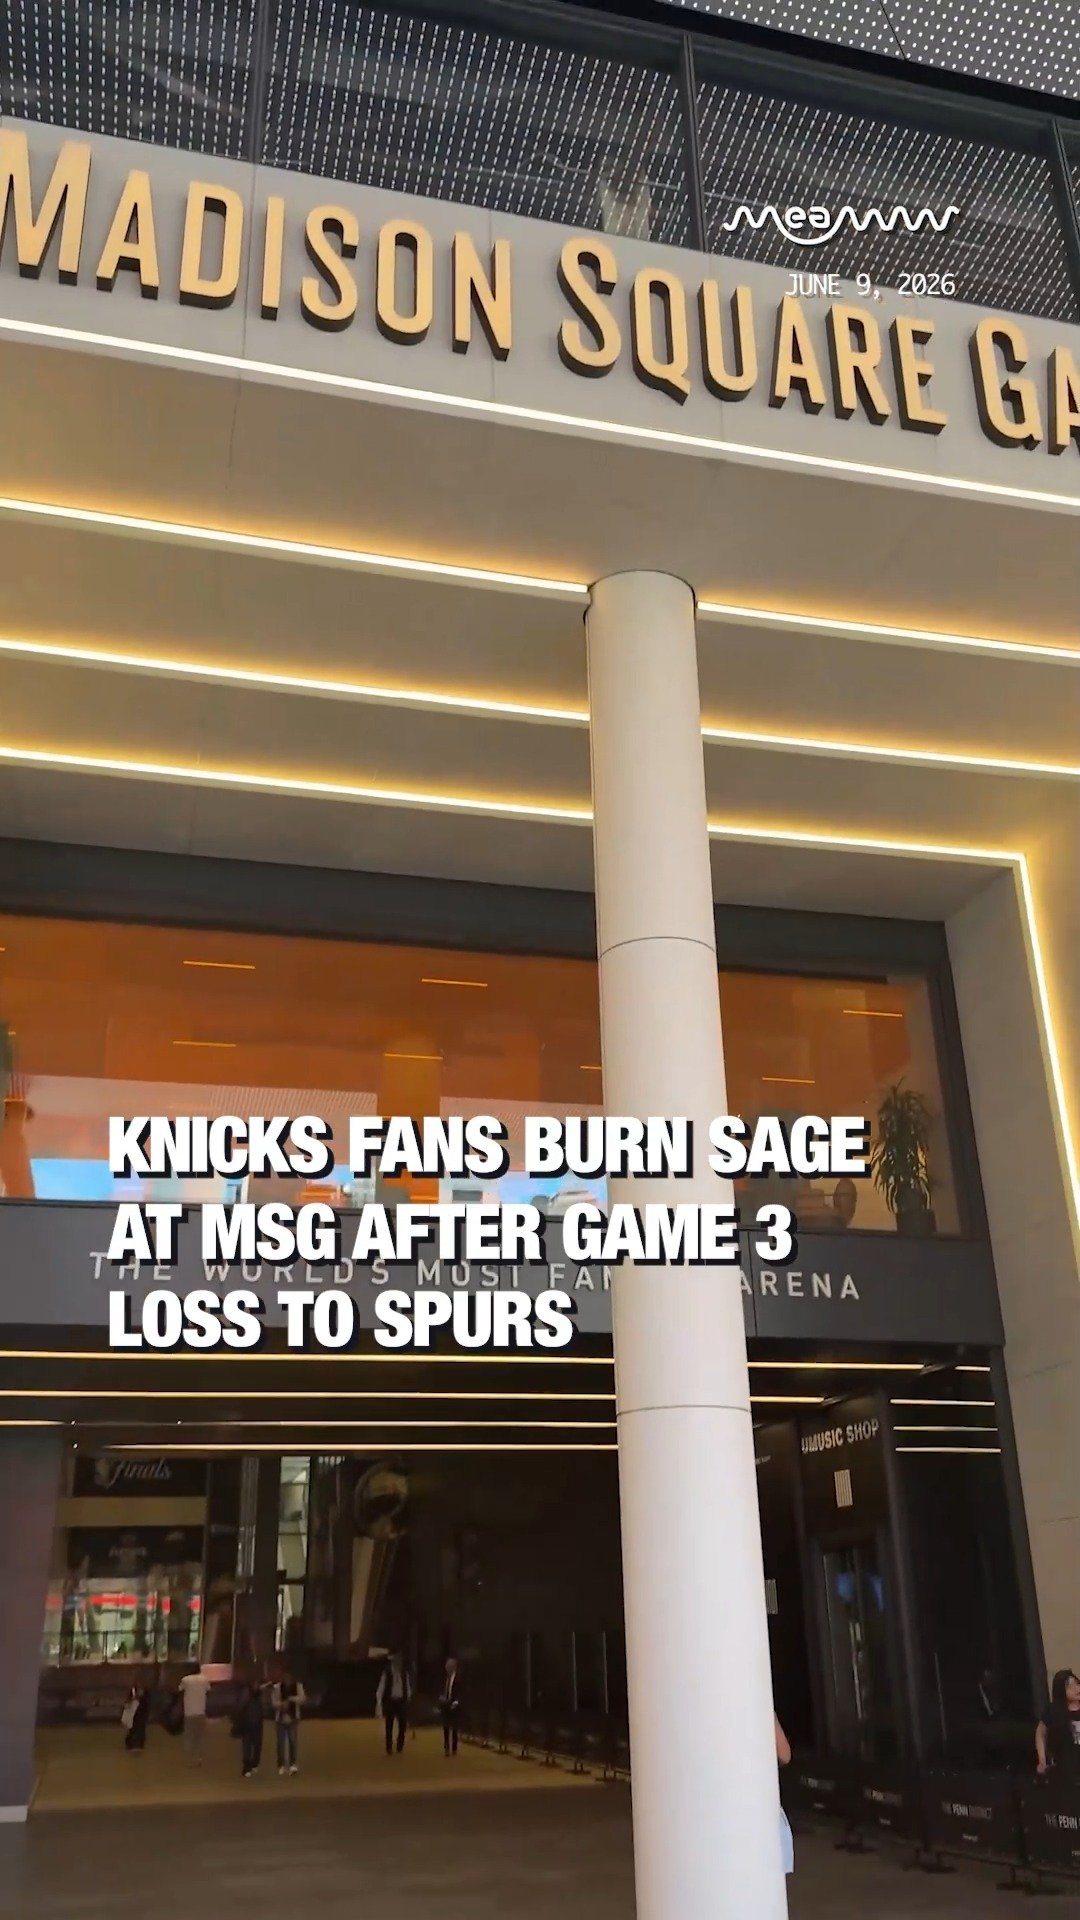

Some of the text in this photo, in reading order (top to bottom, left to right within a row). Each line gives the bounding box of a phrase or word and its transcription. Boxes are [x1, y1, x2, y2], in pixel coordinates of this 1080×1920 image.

[0, 129, 512, 360] MADISON
[558, 236, 950, 433] SQUARE
[416, 1258, 522, 1289] MOST
[846, 1418, 879, 1444] SHOP
